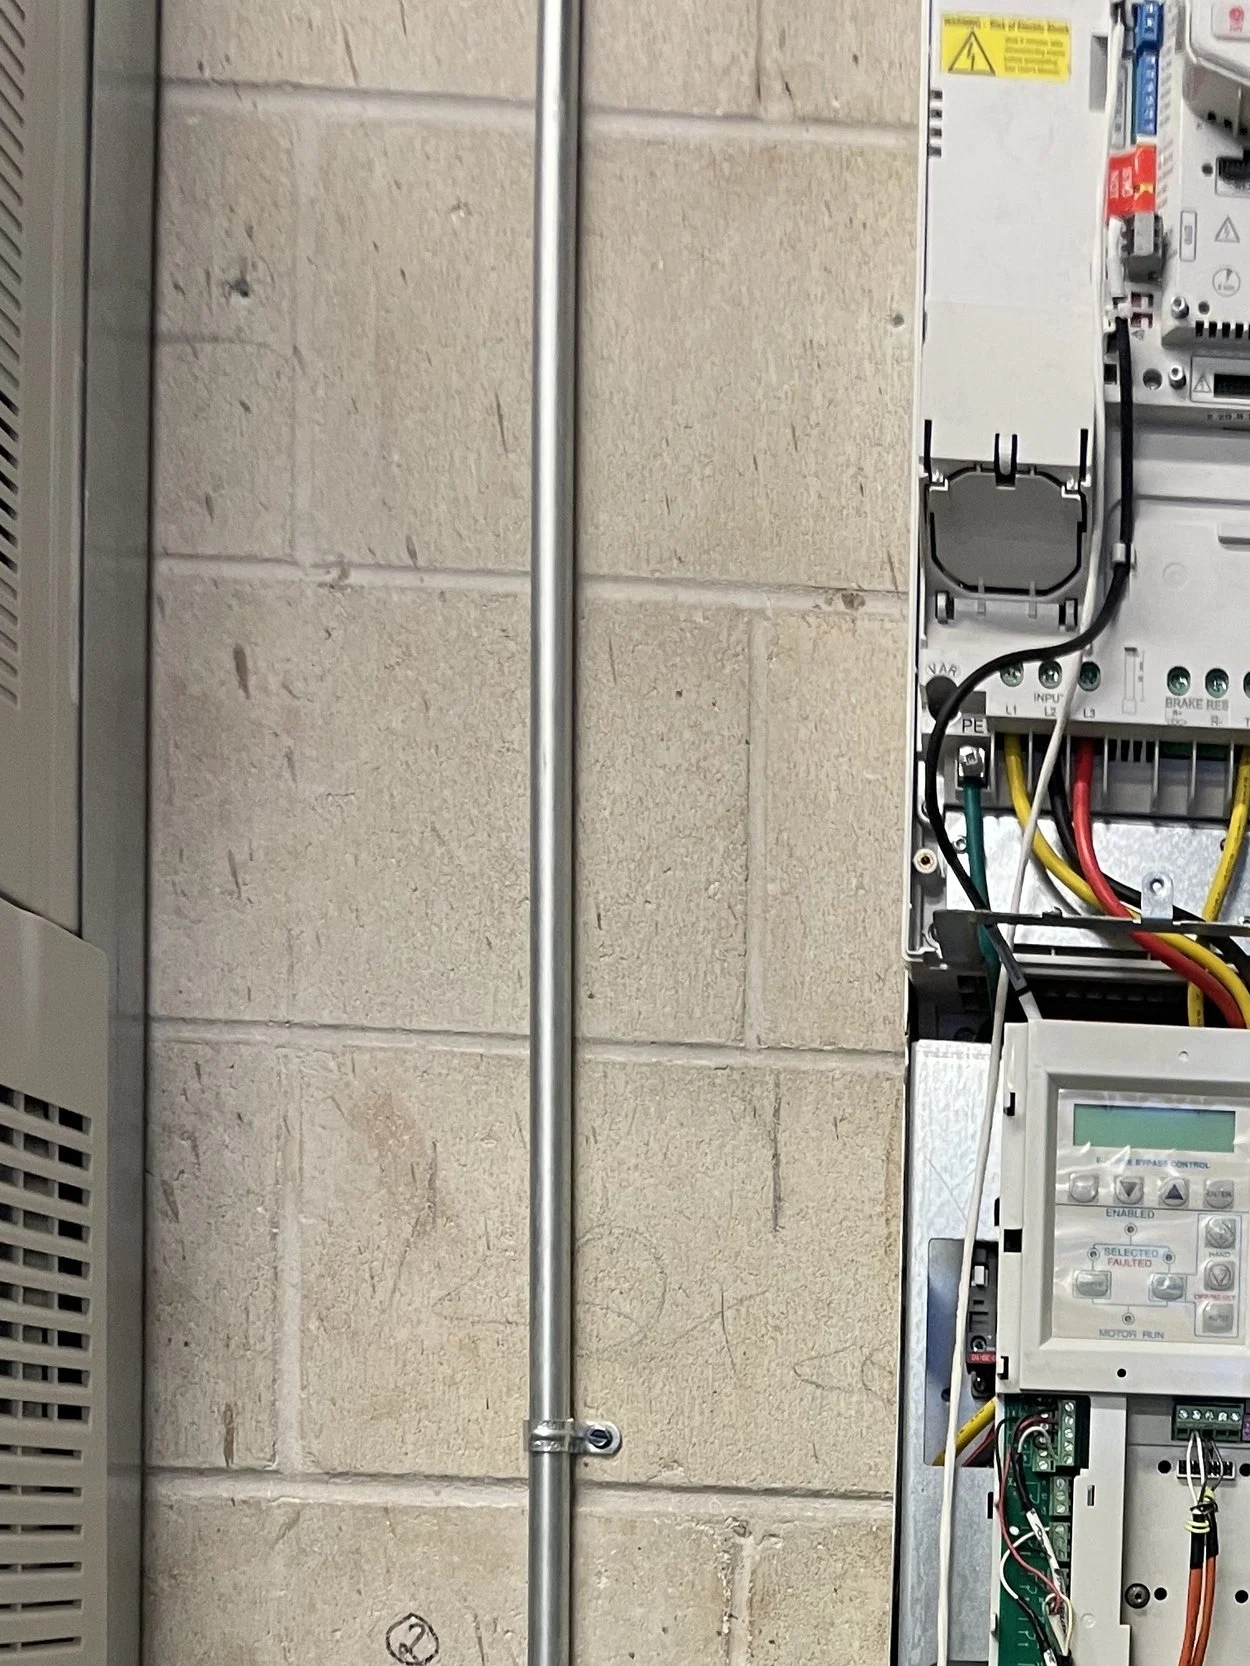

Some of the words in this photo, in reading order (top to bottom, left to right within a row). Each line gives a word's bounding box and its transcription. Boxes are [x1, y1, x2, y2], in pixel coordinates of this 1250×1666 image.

[927, 663, 958, 677] VAR
[1165, 697, 1203, 710] BRAKE
[1206, 699, 1229, 711] RES
[1005, 705, 1017, 716] L1
[1044, 706, 1057, 717] L2
[1083, 707, 1095, 718] L3
[962, 718, 985, 734] PE
[1171, 1160, 1210, 1169] CONTROL
[1106, 1208, 1155, 1219] ENABLED
[1103, 1247, 1159, 1258] SELECTED
[1107, 1258, 1152, 1268] FAULTED
[1099, 1329, 1137, 1339] MOTOR
[1142, 1330, 1164, 1339] RUN
